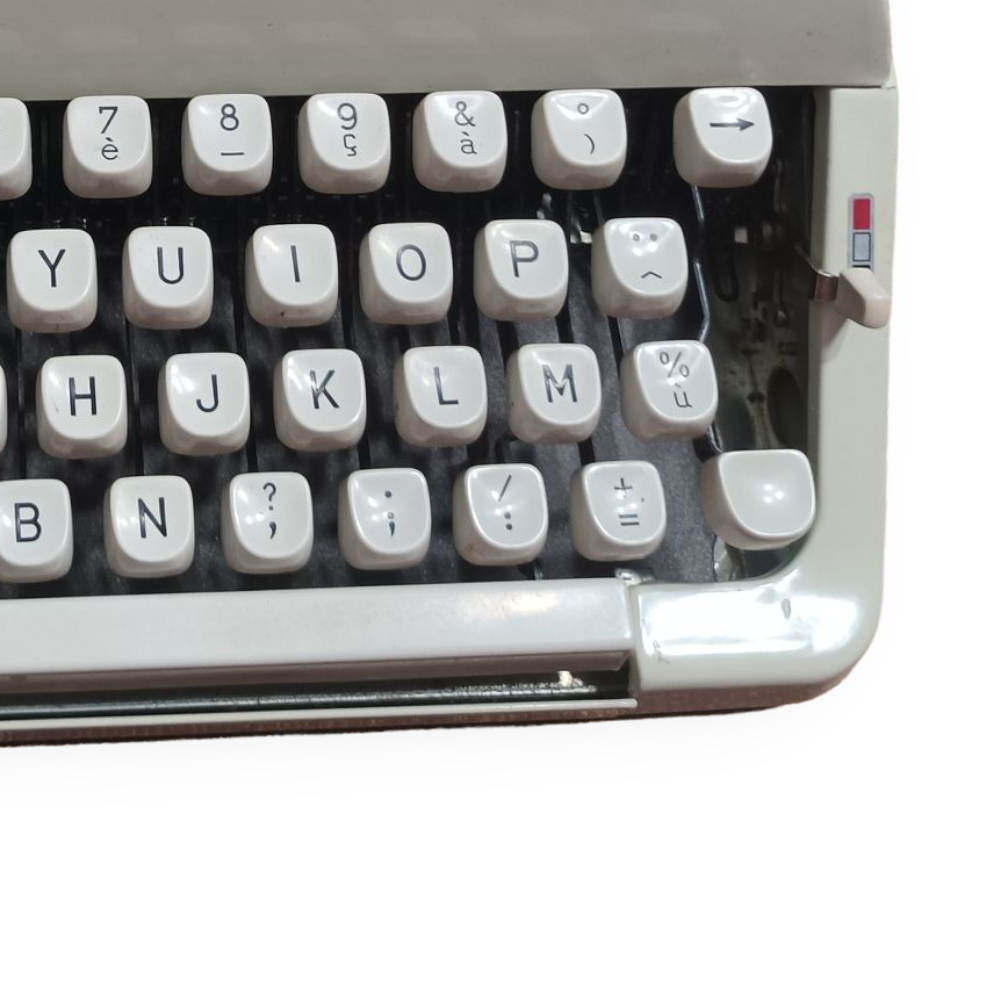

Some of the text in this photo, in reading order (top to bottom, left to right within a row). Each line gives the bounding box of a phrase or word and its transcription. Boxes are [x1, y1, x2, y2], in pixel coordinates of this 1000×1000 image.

[98, 105, 119, 134] 7
[219, 103, 240, 132] 8
[337, 102, 358, 131] 9
[454, 100, 476, 128] &
[101, 136, 119, 161] è
[460, 131, 477, 155] à
[37, 248, 66, 288] Y
[156, 246, 185, 285] U
[290, 245, 301, 283] I
[395, 244, 427, 282] O
[510, 240, 540, 278] P
[543, 364, 578, 403] M
[659, 351, 690, 378] %
[68, 376, 97, 417] H
[196, 374, 219, 413] J
[309, 369, 340, 410] K
[434, 367, 460, 406] L
[673, 383, 693, 409] ù
[262, 482, 278, 512] ?
[14, 502, 42, 543] B
[137, 496, 168, 539] N
